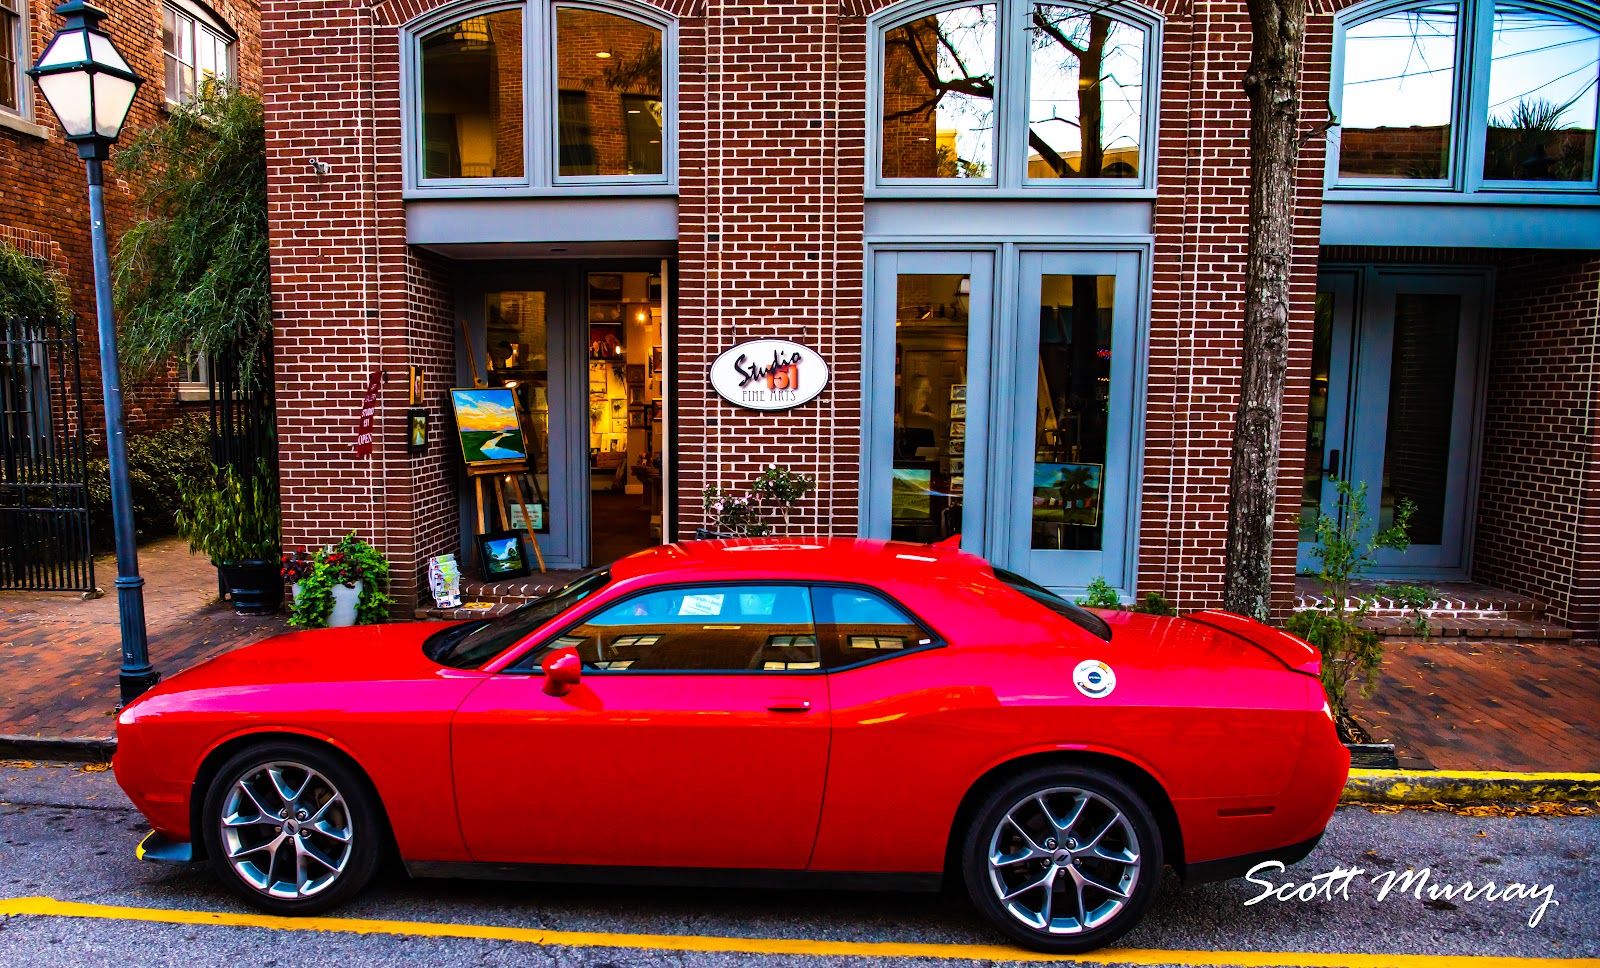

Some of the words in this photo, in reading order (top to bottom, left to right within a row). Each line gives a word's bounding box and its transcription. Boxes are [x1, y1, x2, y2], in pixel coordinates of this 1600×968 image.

[734, 350, 801, 386] Studio
[766, 364, 798, 389] 151
[742, 390, 765, 401] FINE
[770, 390, 796, 401] ARTS
[357, 432, 373, 445] OPEN
